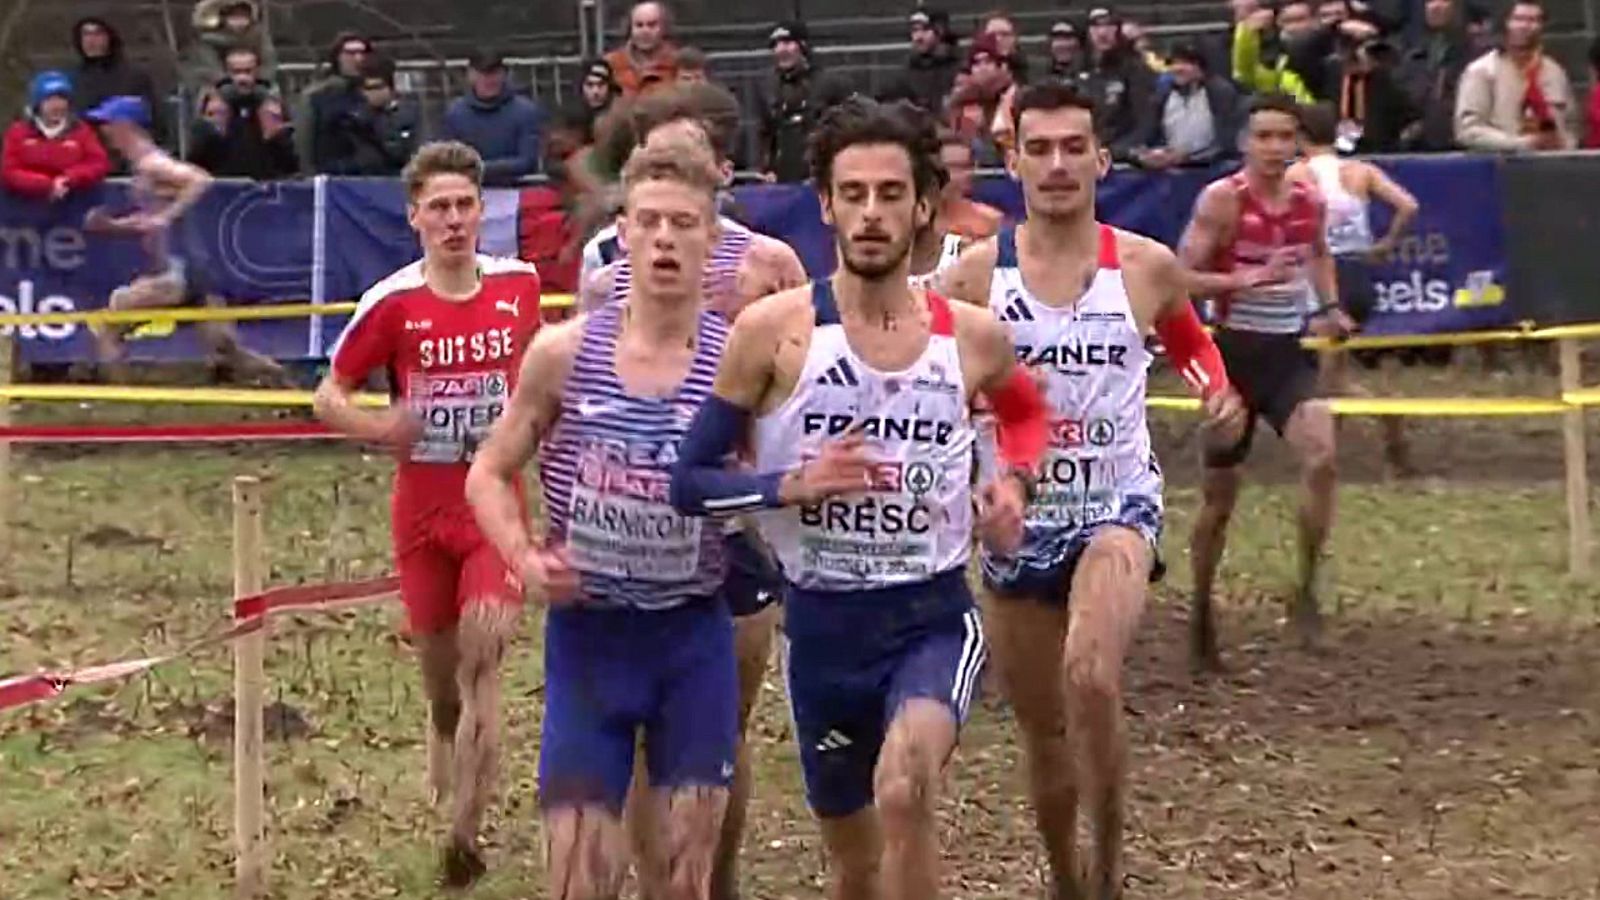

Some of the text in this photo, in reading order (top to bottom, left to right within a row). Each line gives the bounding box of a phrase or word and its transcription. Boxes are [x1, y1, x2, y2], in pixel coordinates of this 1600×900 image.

[420, 328, 513, 367] SUISSE
[804, 413, 953, 445] FRANCE
[800, 498, 930, 534] BRESC
